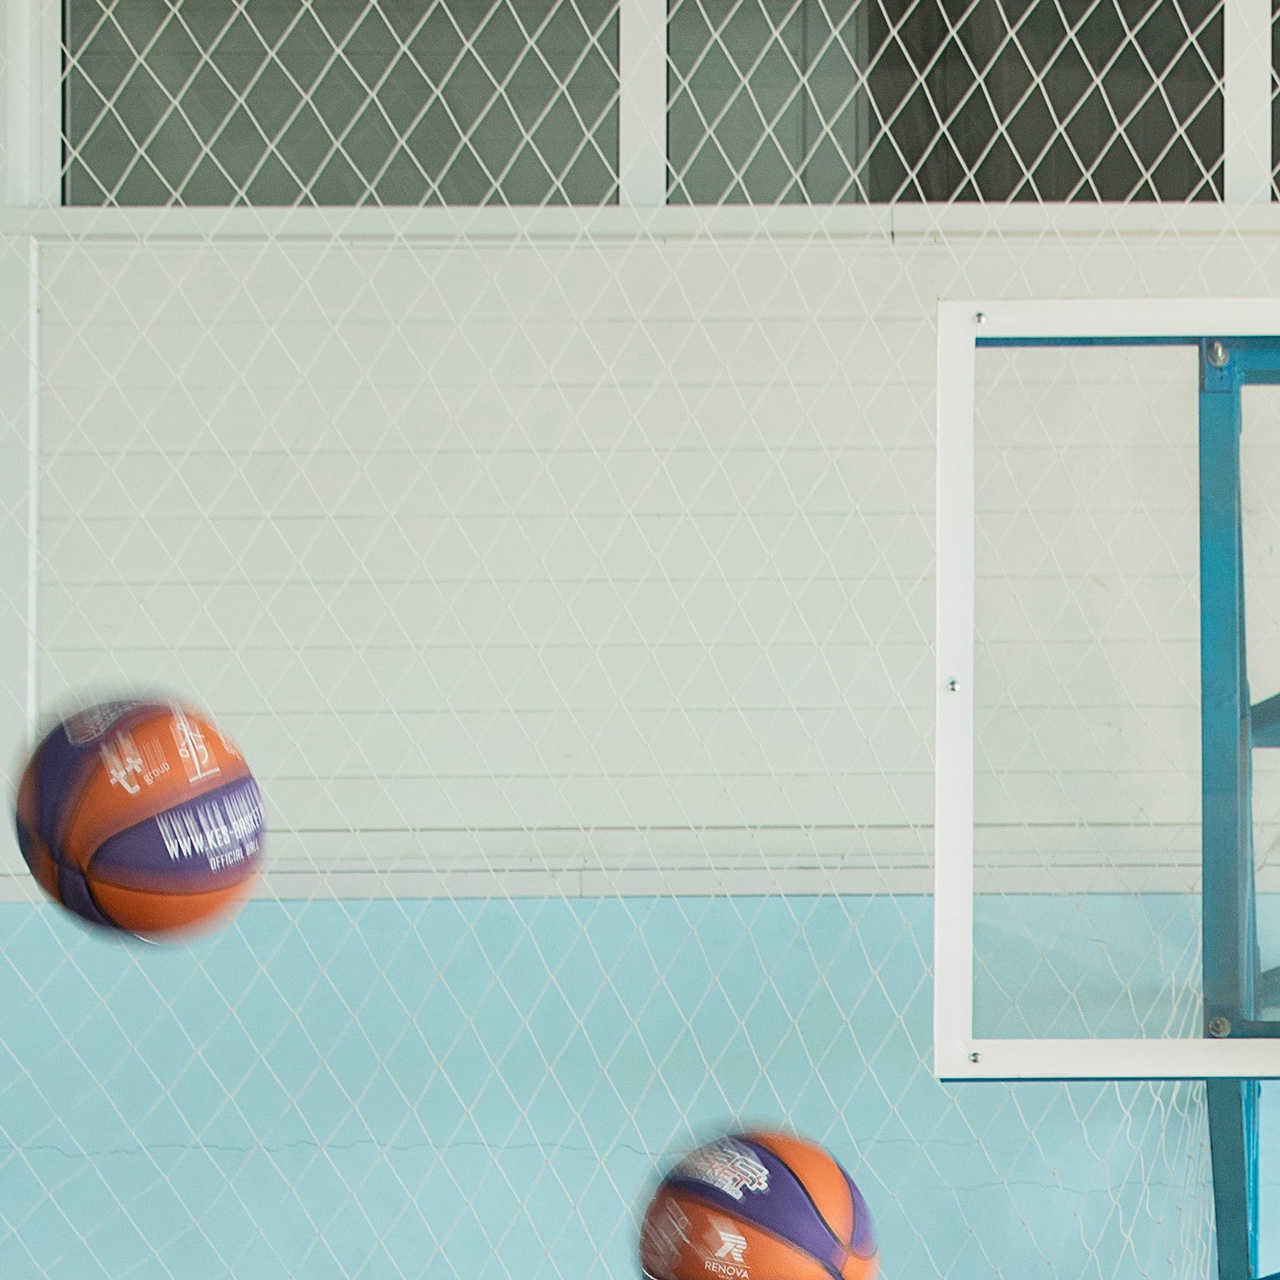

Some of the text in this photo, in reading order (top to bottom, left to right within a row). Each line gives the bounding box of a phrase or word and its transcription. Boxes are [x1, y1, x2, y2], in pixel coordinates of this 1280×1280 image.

[143, 762, 171, 785] group
[210, 847, 245, 874] OFFICIAL
[705, 1260, 750, 1280] RENOVA
